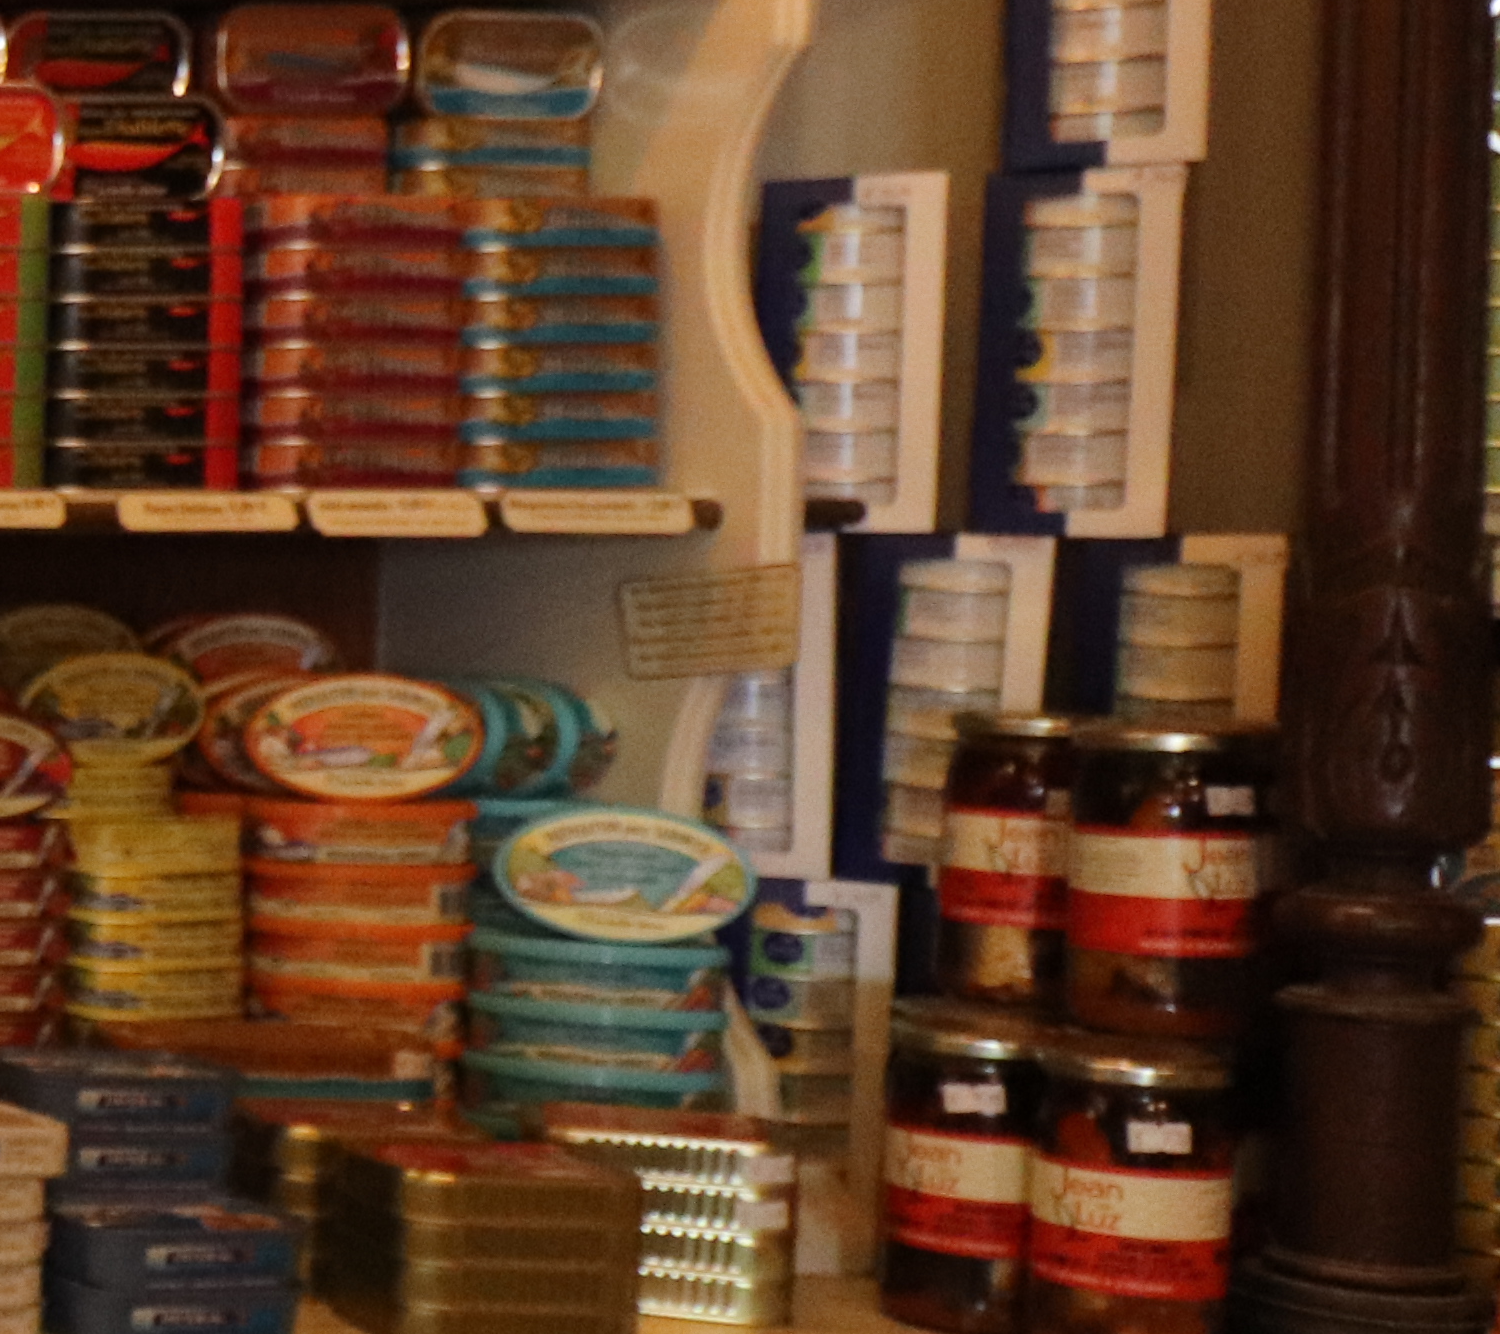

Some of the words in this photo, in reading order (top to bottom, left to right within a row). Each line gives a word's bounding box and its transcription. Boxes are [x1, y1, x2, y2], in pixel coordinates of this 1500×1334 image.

[921, 1165, 960, 1193] Luz
[1054, 1166, 1123, 1201] Jean
[1074, 1200, 1122, 1230] Luz
